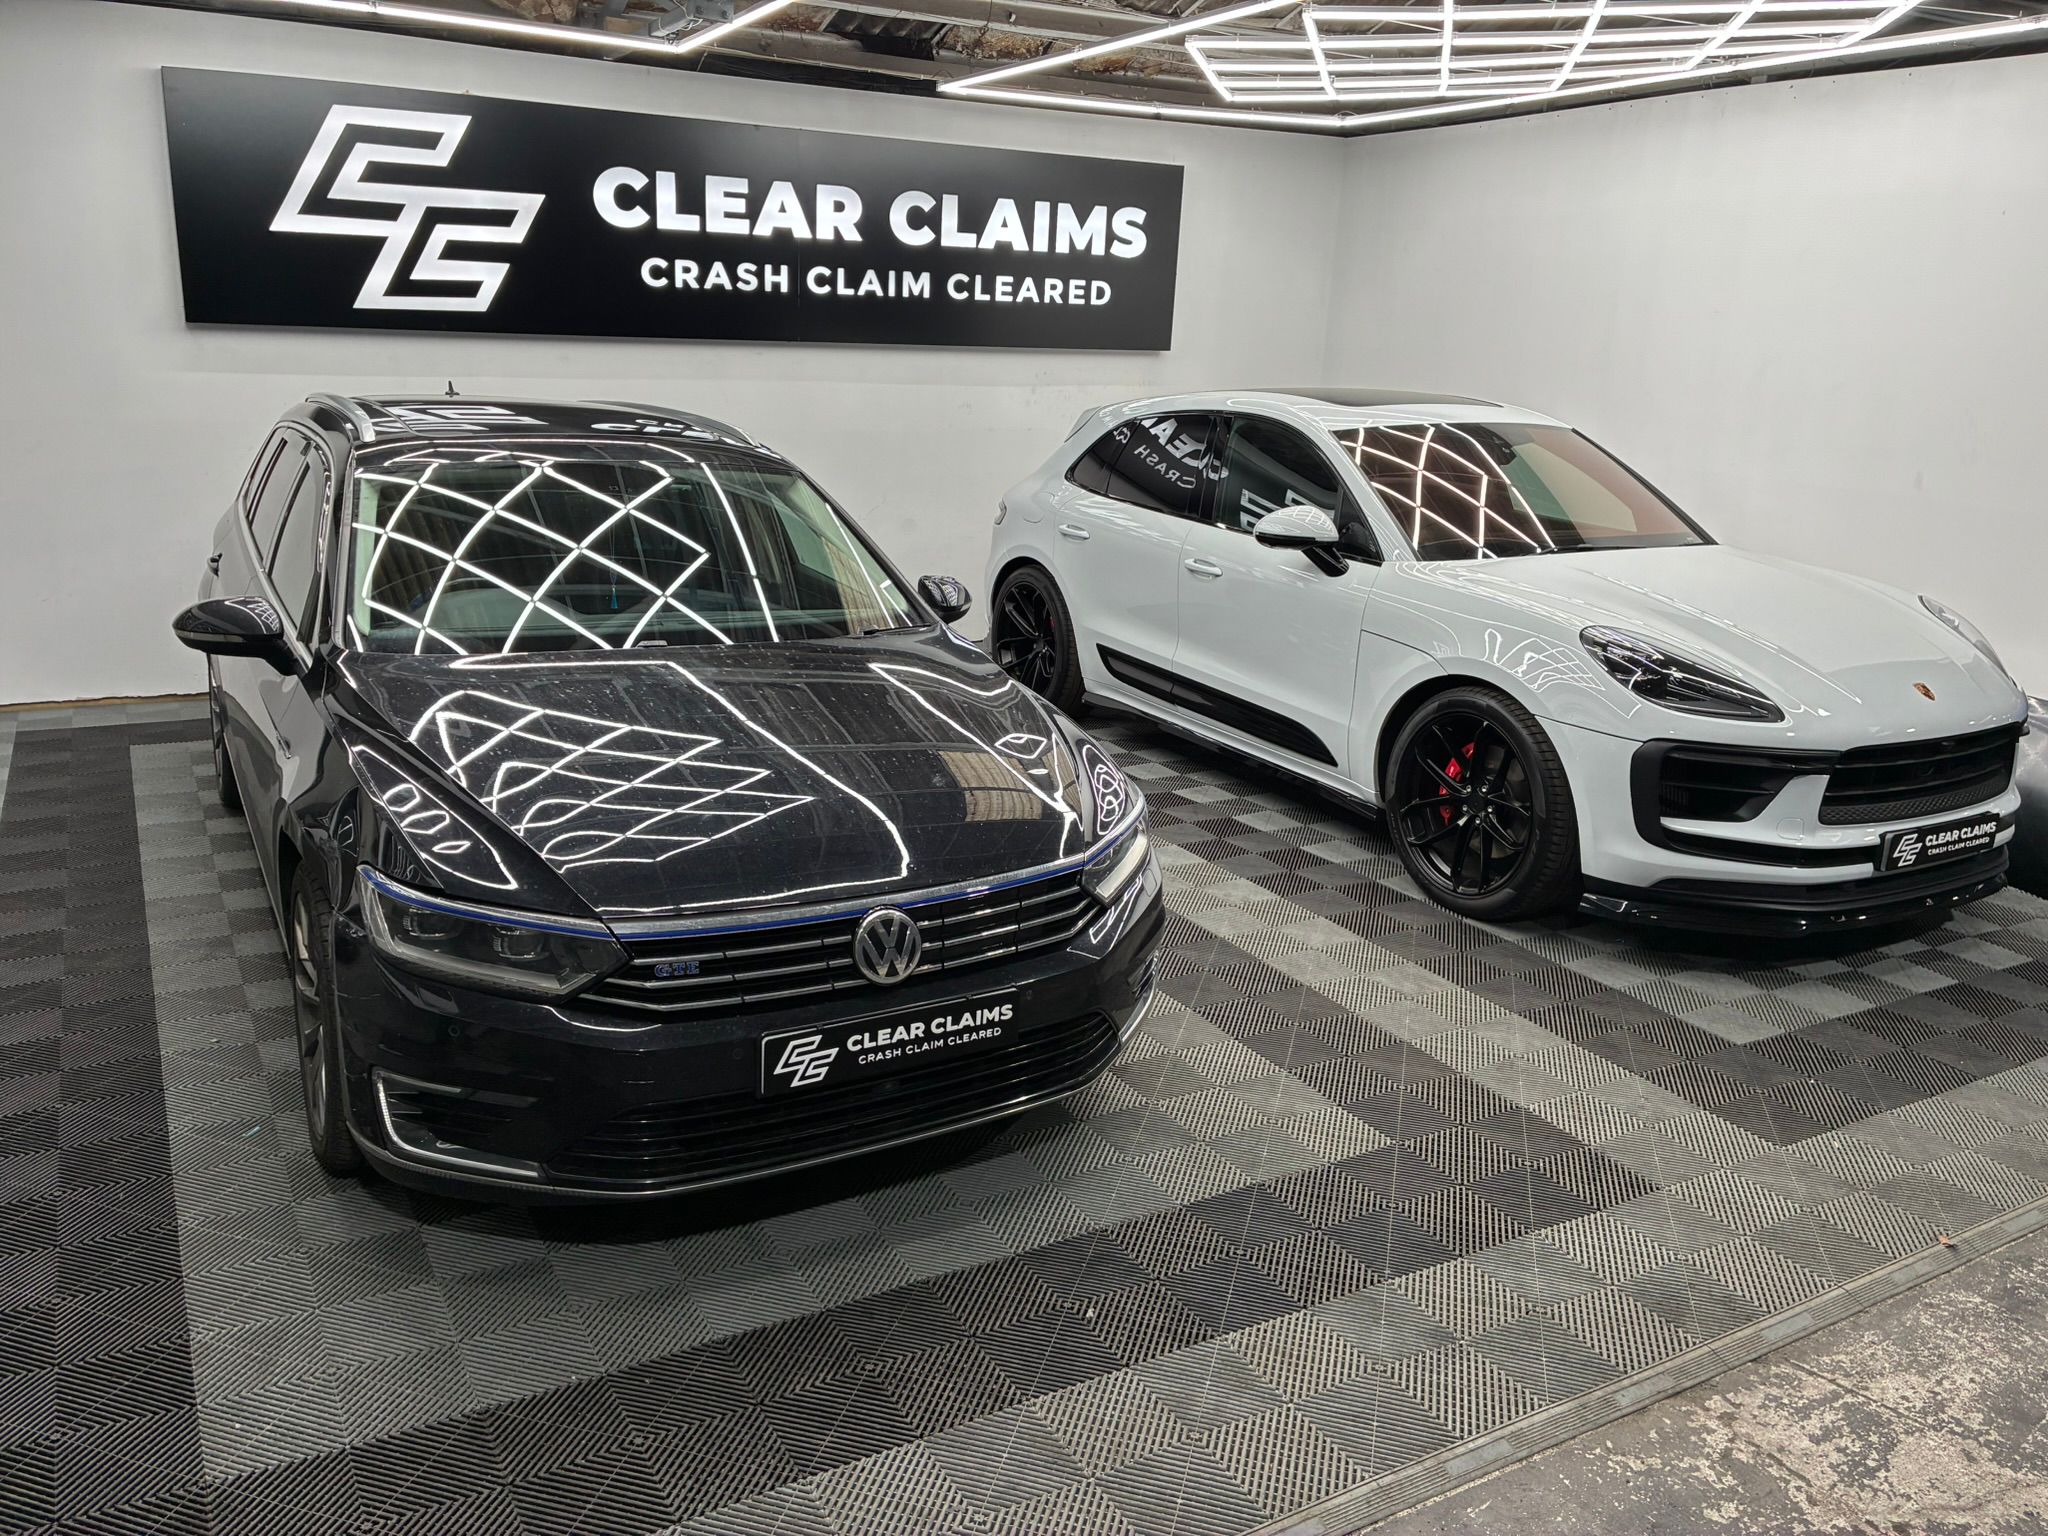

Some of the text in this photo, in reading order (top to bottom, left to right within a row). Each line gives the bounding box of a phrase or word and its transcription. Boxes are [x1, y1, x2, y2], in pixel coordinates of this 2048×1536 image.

[593, 167, 1147, 258] CLEAR CLAIMS
[641, 258, 1111, 305] CRASH CLAIM CLEARED
[1925, 821, 1997, 846] CLEAR CLAIMS
[1928, 846, 1947, 856] CRASH
[1947, 842, 1965, 851] CLAIM
[654, 961, 701, 978] GTE
[847, 1004, 1013, 1051] CLEAR CLAIMS
[858, 1027, 1002, 1064] CRASH CLAIM CLEARED
